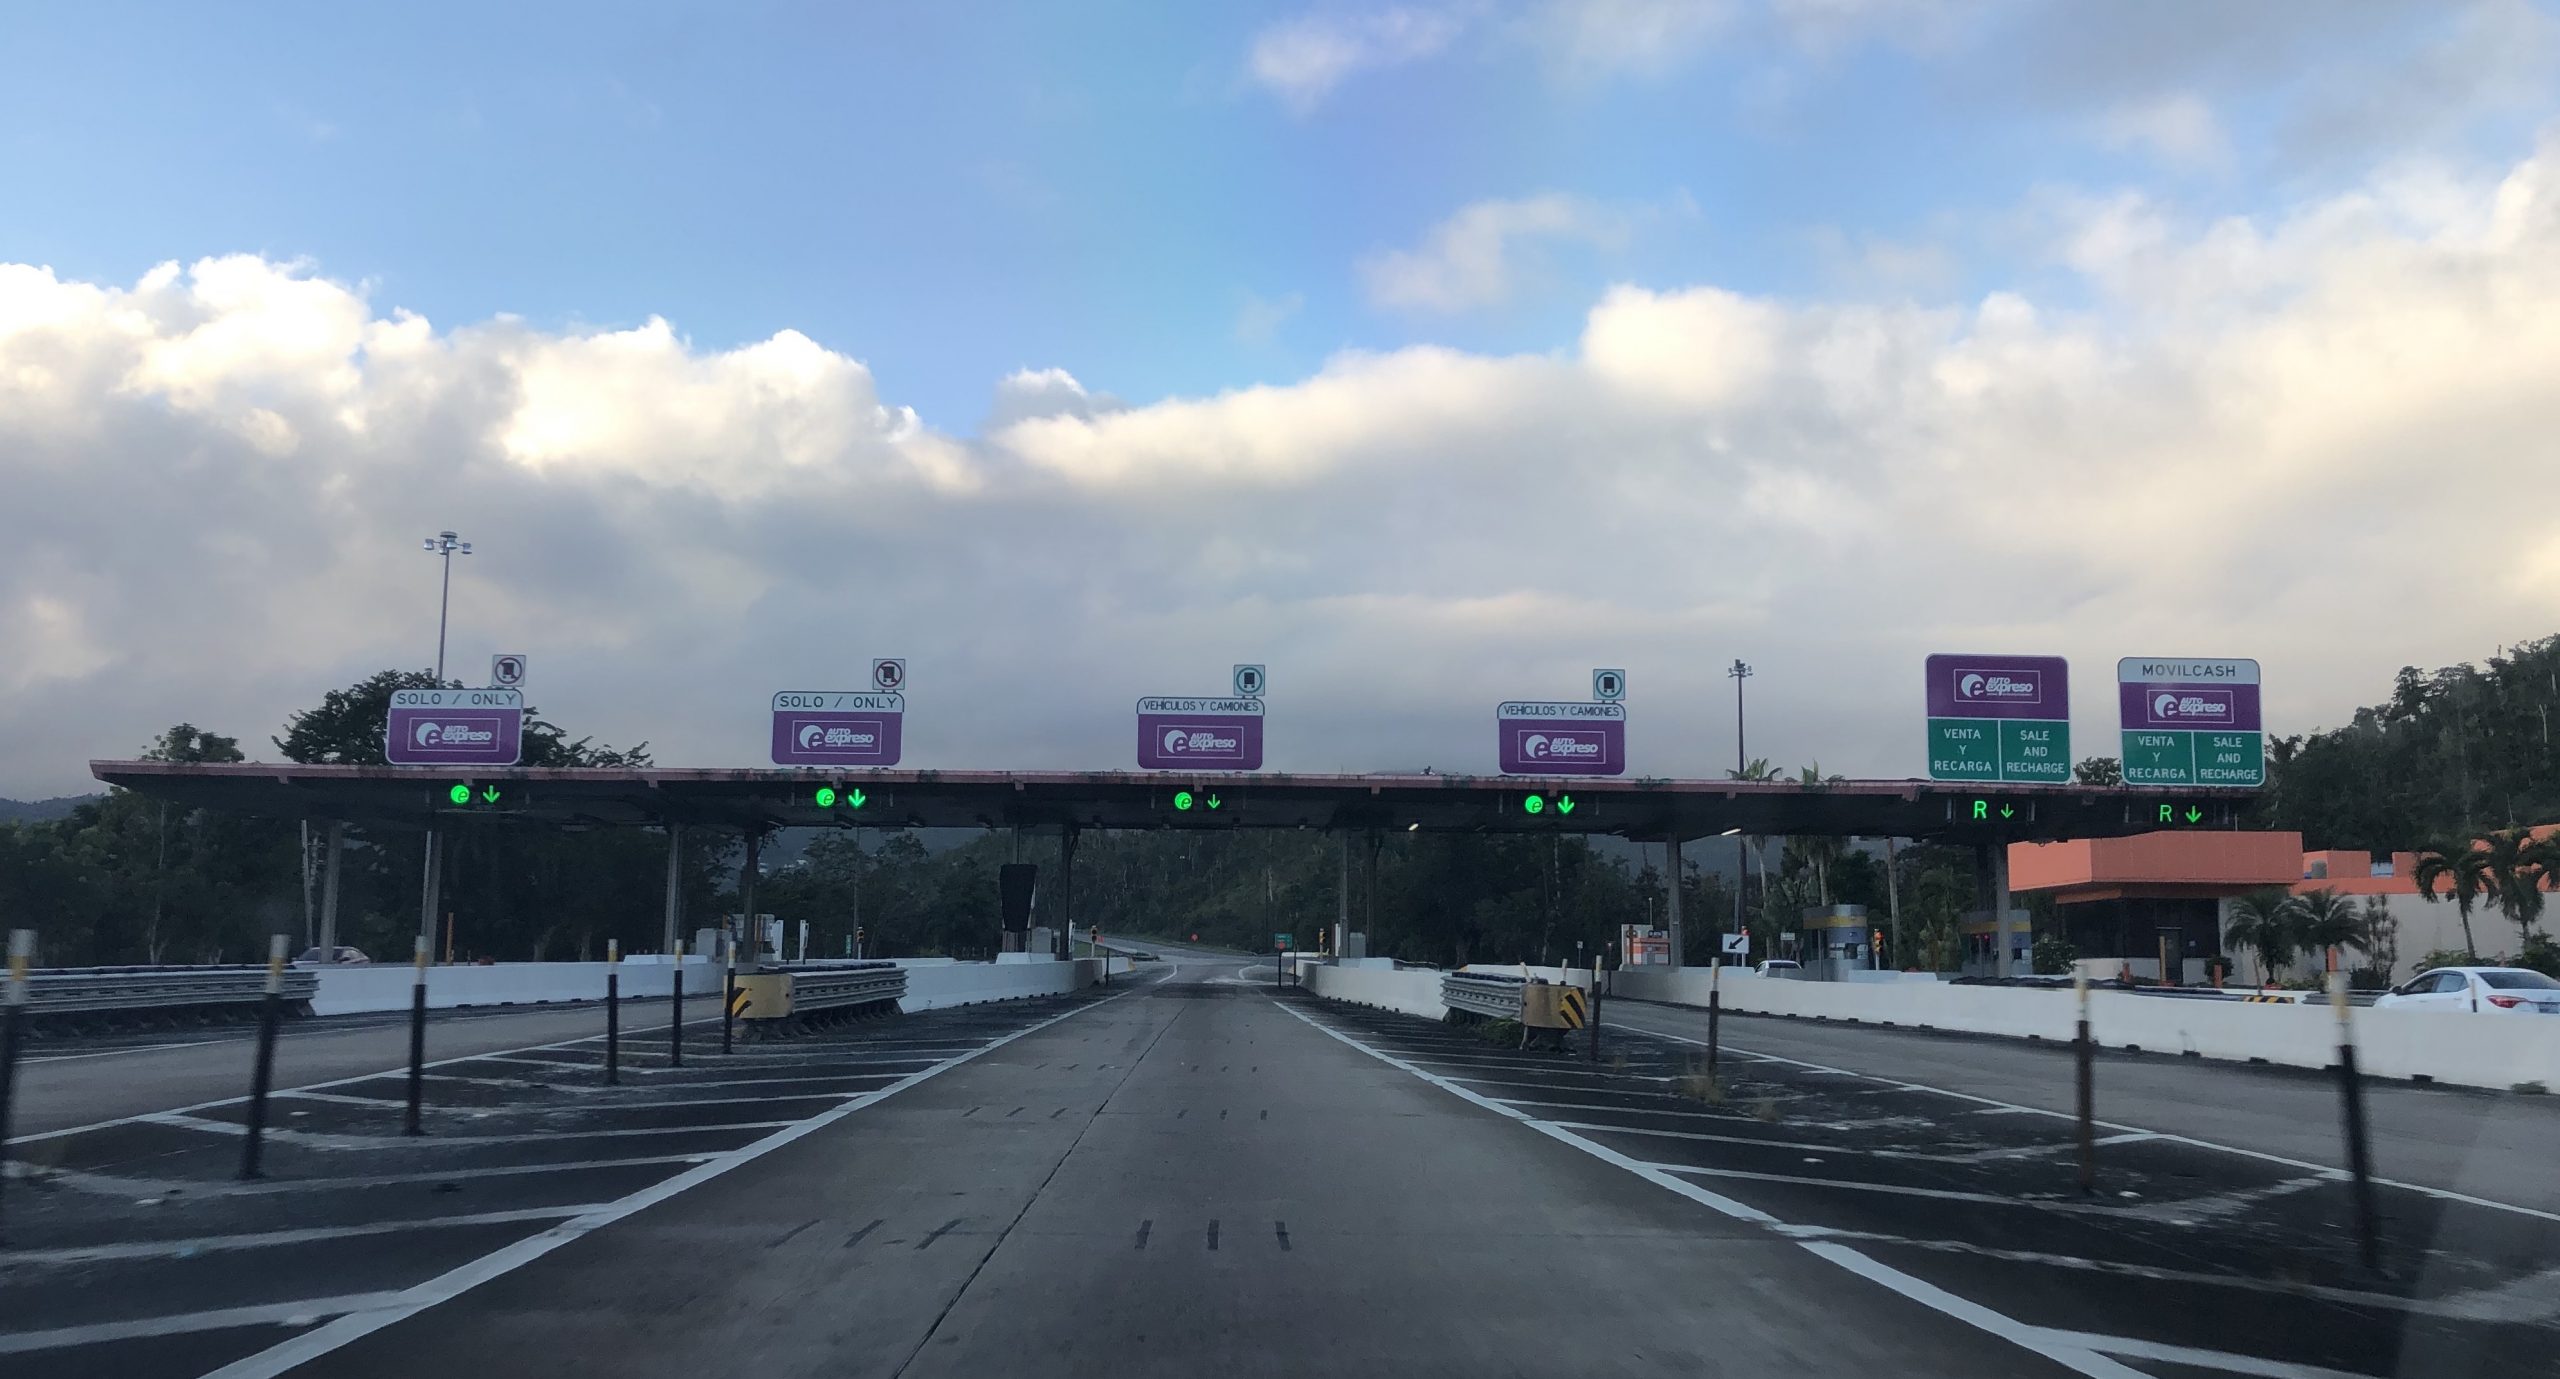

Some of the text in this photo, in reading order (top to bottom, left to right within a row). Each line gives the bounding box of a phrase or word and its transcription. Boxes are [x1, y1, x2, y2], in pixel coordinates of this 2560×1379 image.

[2142, 664, 2236, 677] MOVILCASH
[1986, 682, 2033, 696] expreso
[396, 693, 517, 705] SOLO / ONLY
[779, 695, 897, 709] SOLO / ONLY
[1200, 701, 1206, 711] Y
[1210, 701, 1259, 712] CAMIONES
[1559, 706, 1567, 716] Y
[1570, 706, 1619, 717] CAMIONES
[2179, 702, 2226, 716] expreso
[441, 730, 492, 744] expreso
[824, 733, 874, 747] expreso
[1944, 728, 1981, 740] VENTA
[2020, 730, 2050, 741] SALE
[1188, 738, 1236, 751] expreso
[2138, 736, 2175, 747] VENTA
[2213, 737, 2243, 748] SALE
[1550, 742, 1598, 756] expreso
[1959, 745, 1967, 755] Y
[2024, 747, 2048, 757] AND
[2153, 752, 2161, 762] Y
[2217, 753, 2241, 764] AND
[1934, 760, 1992, 772] RECARGA
[2007, 762, 2065, 774] RECHARGE
[2128, 768, 2186, 779] RECARGA
[2200, 768, 2258, 780] RECHARGE
[1973, 800, 1987, 819] R
[2160, 804, 2172, 822] R
